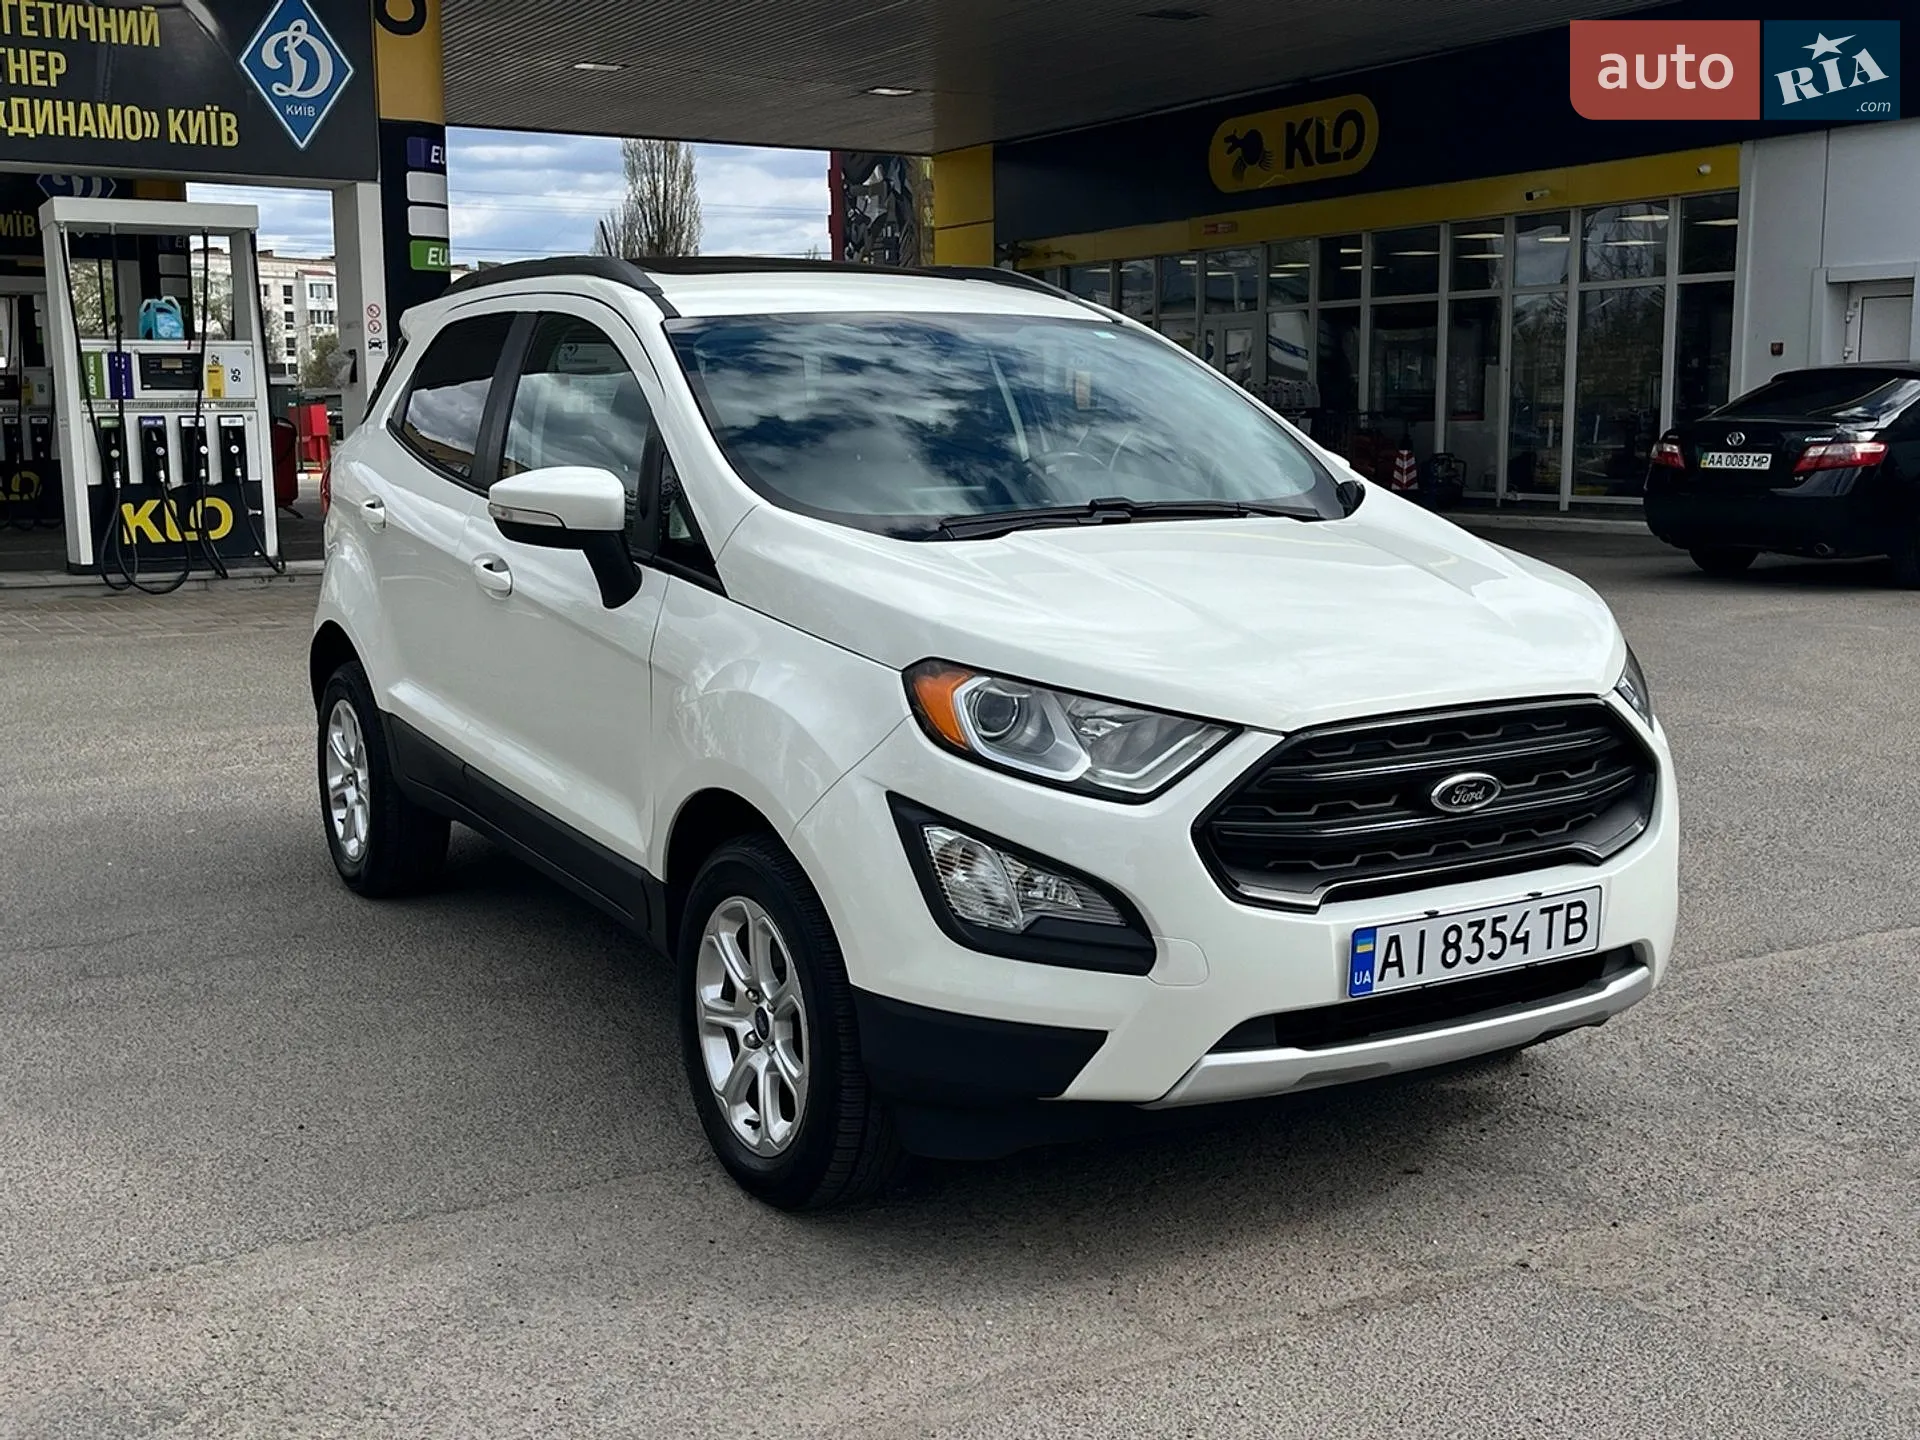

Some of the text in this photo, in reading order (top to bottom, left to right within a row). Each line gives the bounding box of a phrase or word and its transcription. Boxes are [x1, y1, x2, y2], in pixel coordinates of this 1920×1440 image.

[167, 103, 239, 147] КИЇВ
[1285, 108, 1366, 171] KLO
[230, 367, 242, 383] 95
[1708, 454, 1769, 468] AA 0083 MP
[121, 497, 234, 544] KLO
[1451, 782, 1486, 806] Ford
[1378, 900, 1589, 983] AI 8354 TB
[1353, 971, 1372, 986] UA
